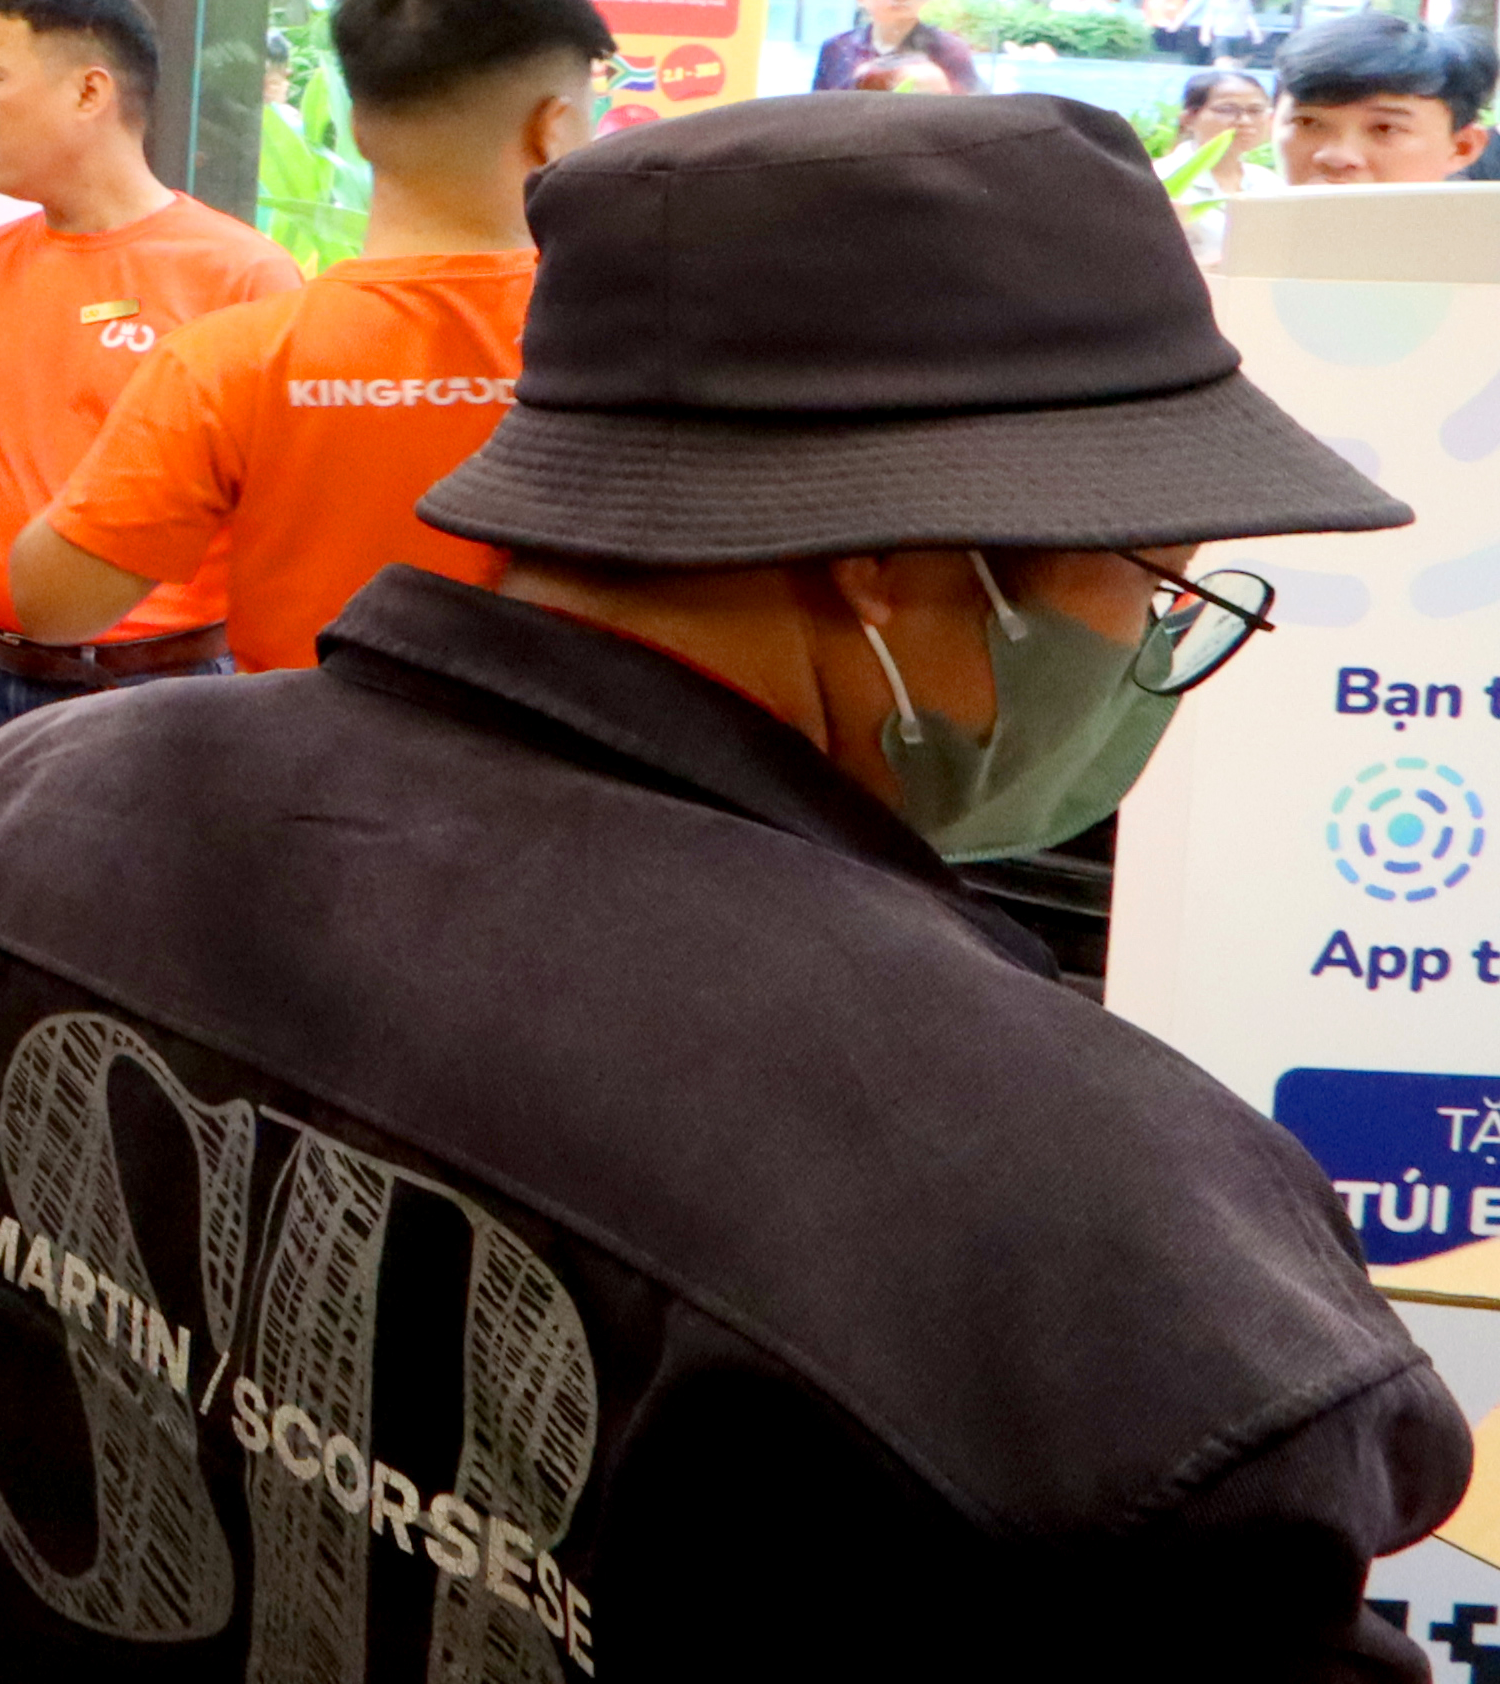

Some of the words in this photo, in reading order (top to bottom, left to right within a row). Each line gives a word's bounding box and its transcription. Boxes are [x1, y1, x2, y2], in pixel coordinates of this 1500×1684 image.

[1335, 666, 1463, 732] Bạn
[1310, 928, 1452, 993] App
[1334, 1167, 1449, 1236] TÚI
[230, 1374, 597, 1678] SCORSESE
